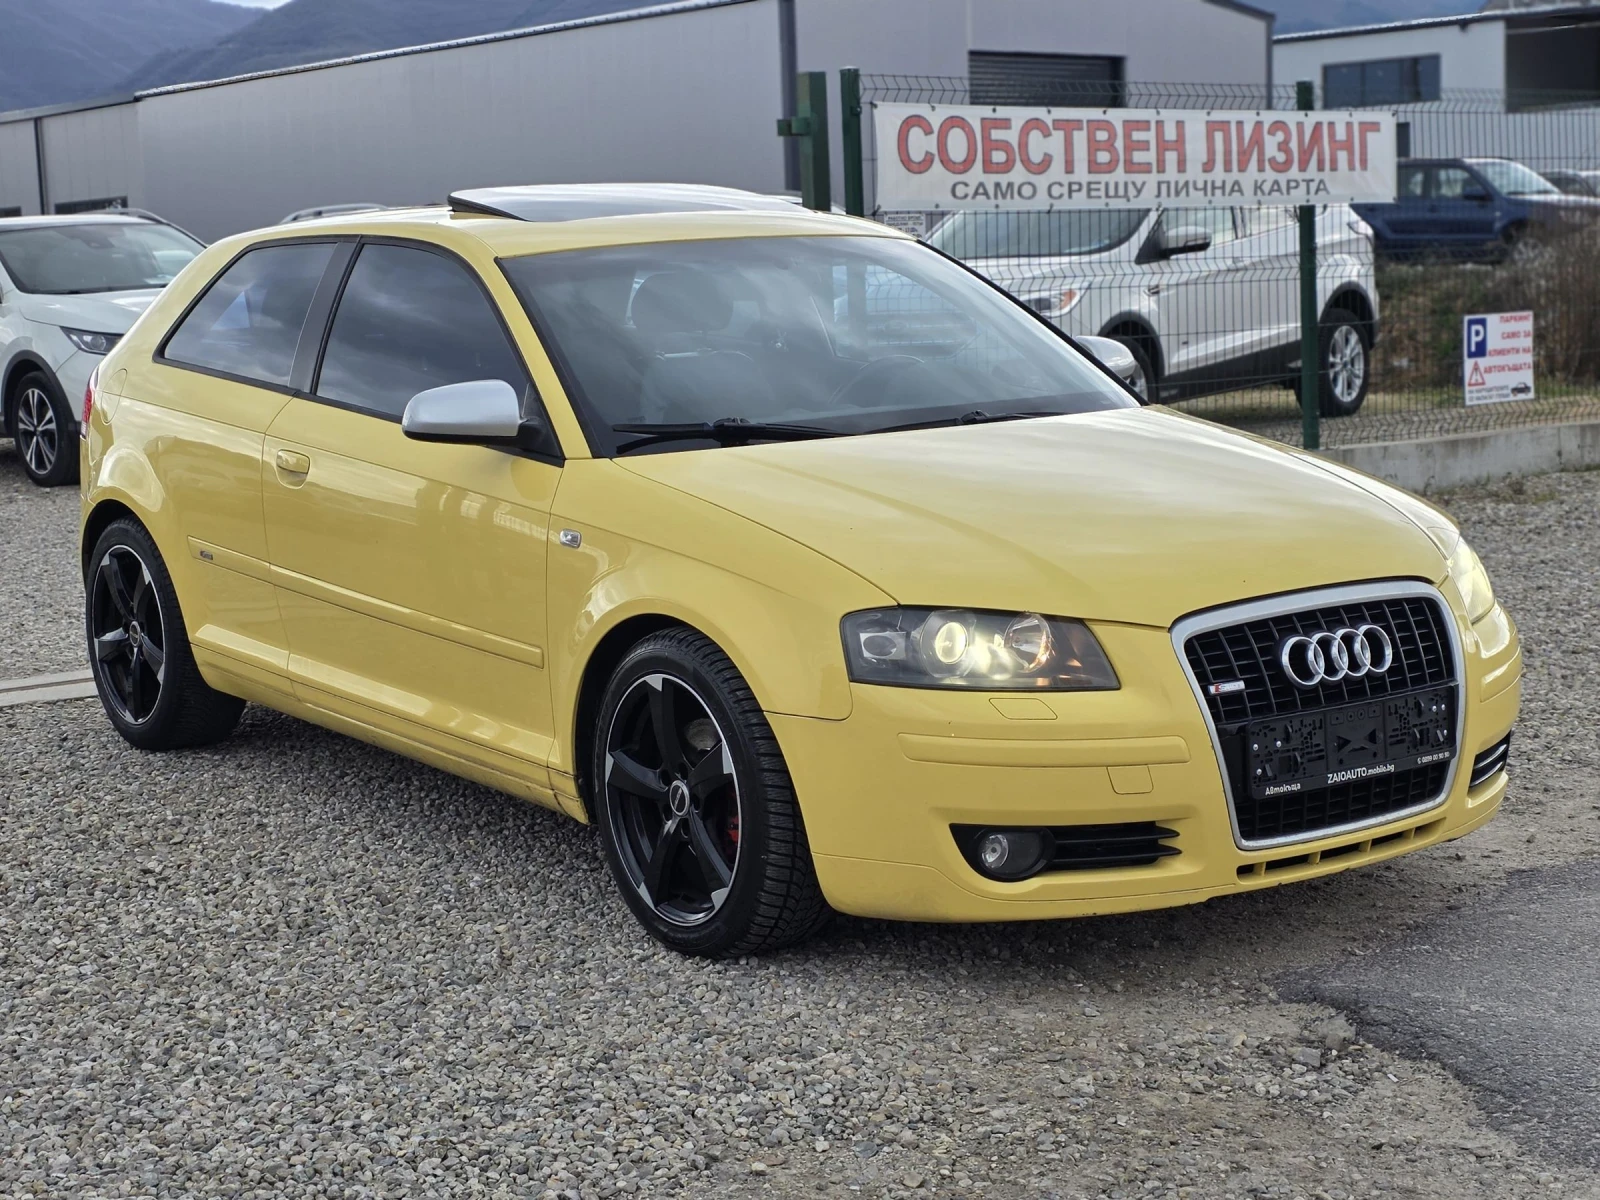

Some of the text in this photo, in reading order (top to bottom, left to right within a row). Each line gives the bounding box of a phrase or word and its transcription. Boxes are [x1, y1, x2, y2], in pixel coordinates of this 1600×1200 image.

[897, 114, 1381, 175] СОБСТВЕН ЛИЗИНГ
[951, 178, 1331, 203] САМО СРЕЩУ ЛИЧНА КАРТА
